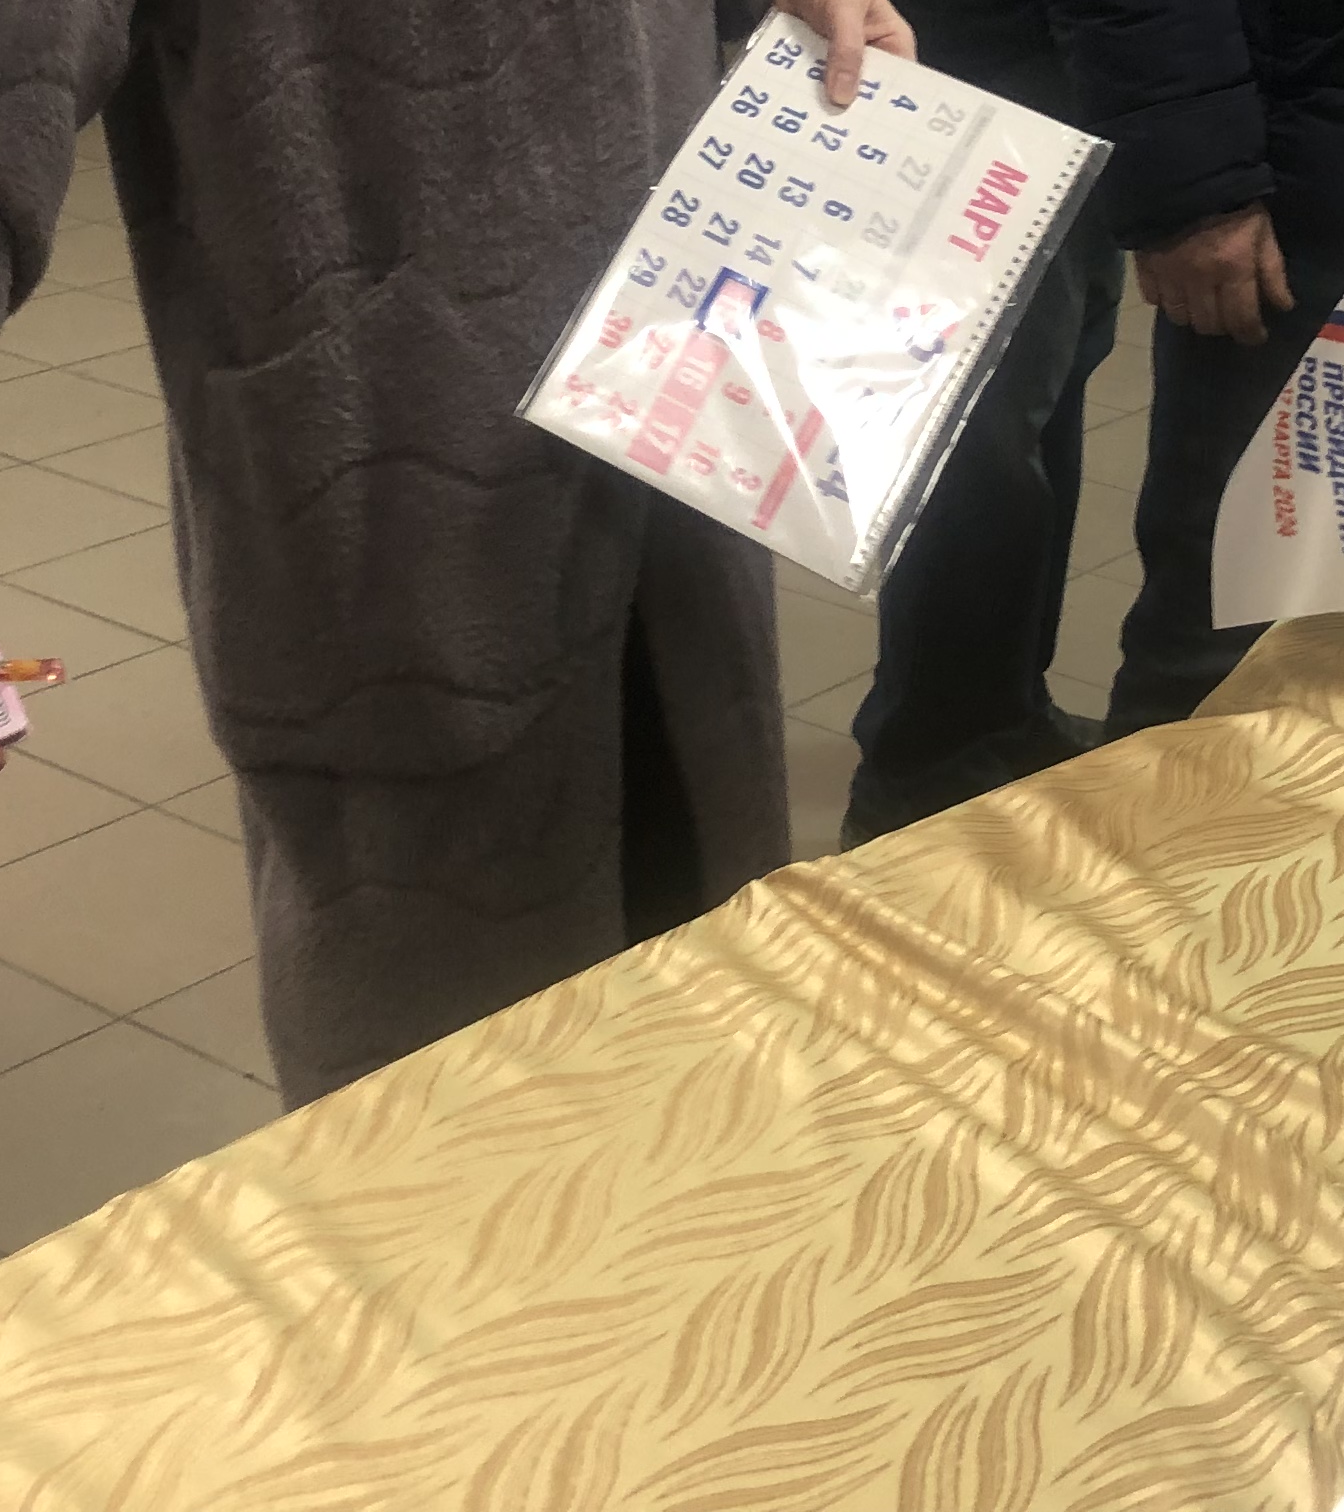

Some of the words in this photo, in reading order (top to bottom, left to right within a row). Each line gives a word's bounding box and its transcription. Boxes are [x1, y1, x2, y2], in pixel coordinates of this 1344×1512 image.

[764, 37, 804, 71] 25
[731, 84, 770, 119] 26
[889, 93, 920, 113] 4
[926, 101, 967, 137] 26
[771, 105, 810, 135] 19
[810, 122, 850, 153] 12
[696, 134, 735, 171] 27
[856, 143, 889, 165] 5
[736, 152, 776, 191] 20
[896, 154, 934, 192] 27
[660, 188, 702, 228] 28
[777, 174, 817, 208] 13
[701, 211, 743, 247] 21
[822, 199, 855, 223] 6
[946, 159, 1030, 263] МАРТ
[861, 211, 901, 250] 28
[627, 246, 668, 289] 29
[744, 232, 785, 267] 14
[666, 267, 707, 309] 22
[791, 259, 821, 282] 7
[757, 318, 788, 344] 8
[675, 355, 718, 391] 16
[722, 381, 752, 406] 9
[1294, 355, 1323, 475] РОССИИ
[644, 419, 684, 455] 17
[1272, 410, 1293, 480] МАРТА
[1272, 484, 1298, 538] 2024
